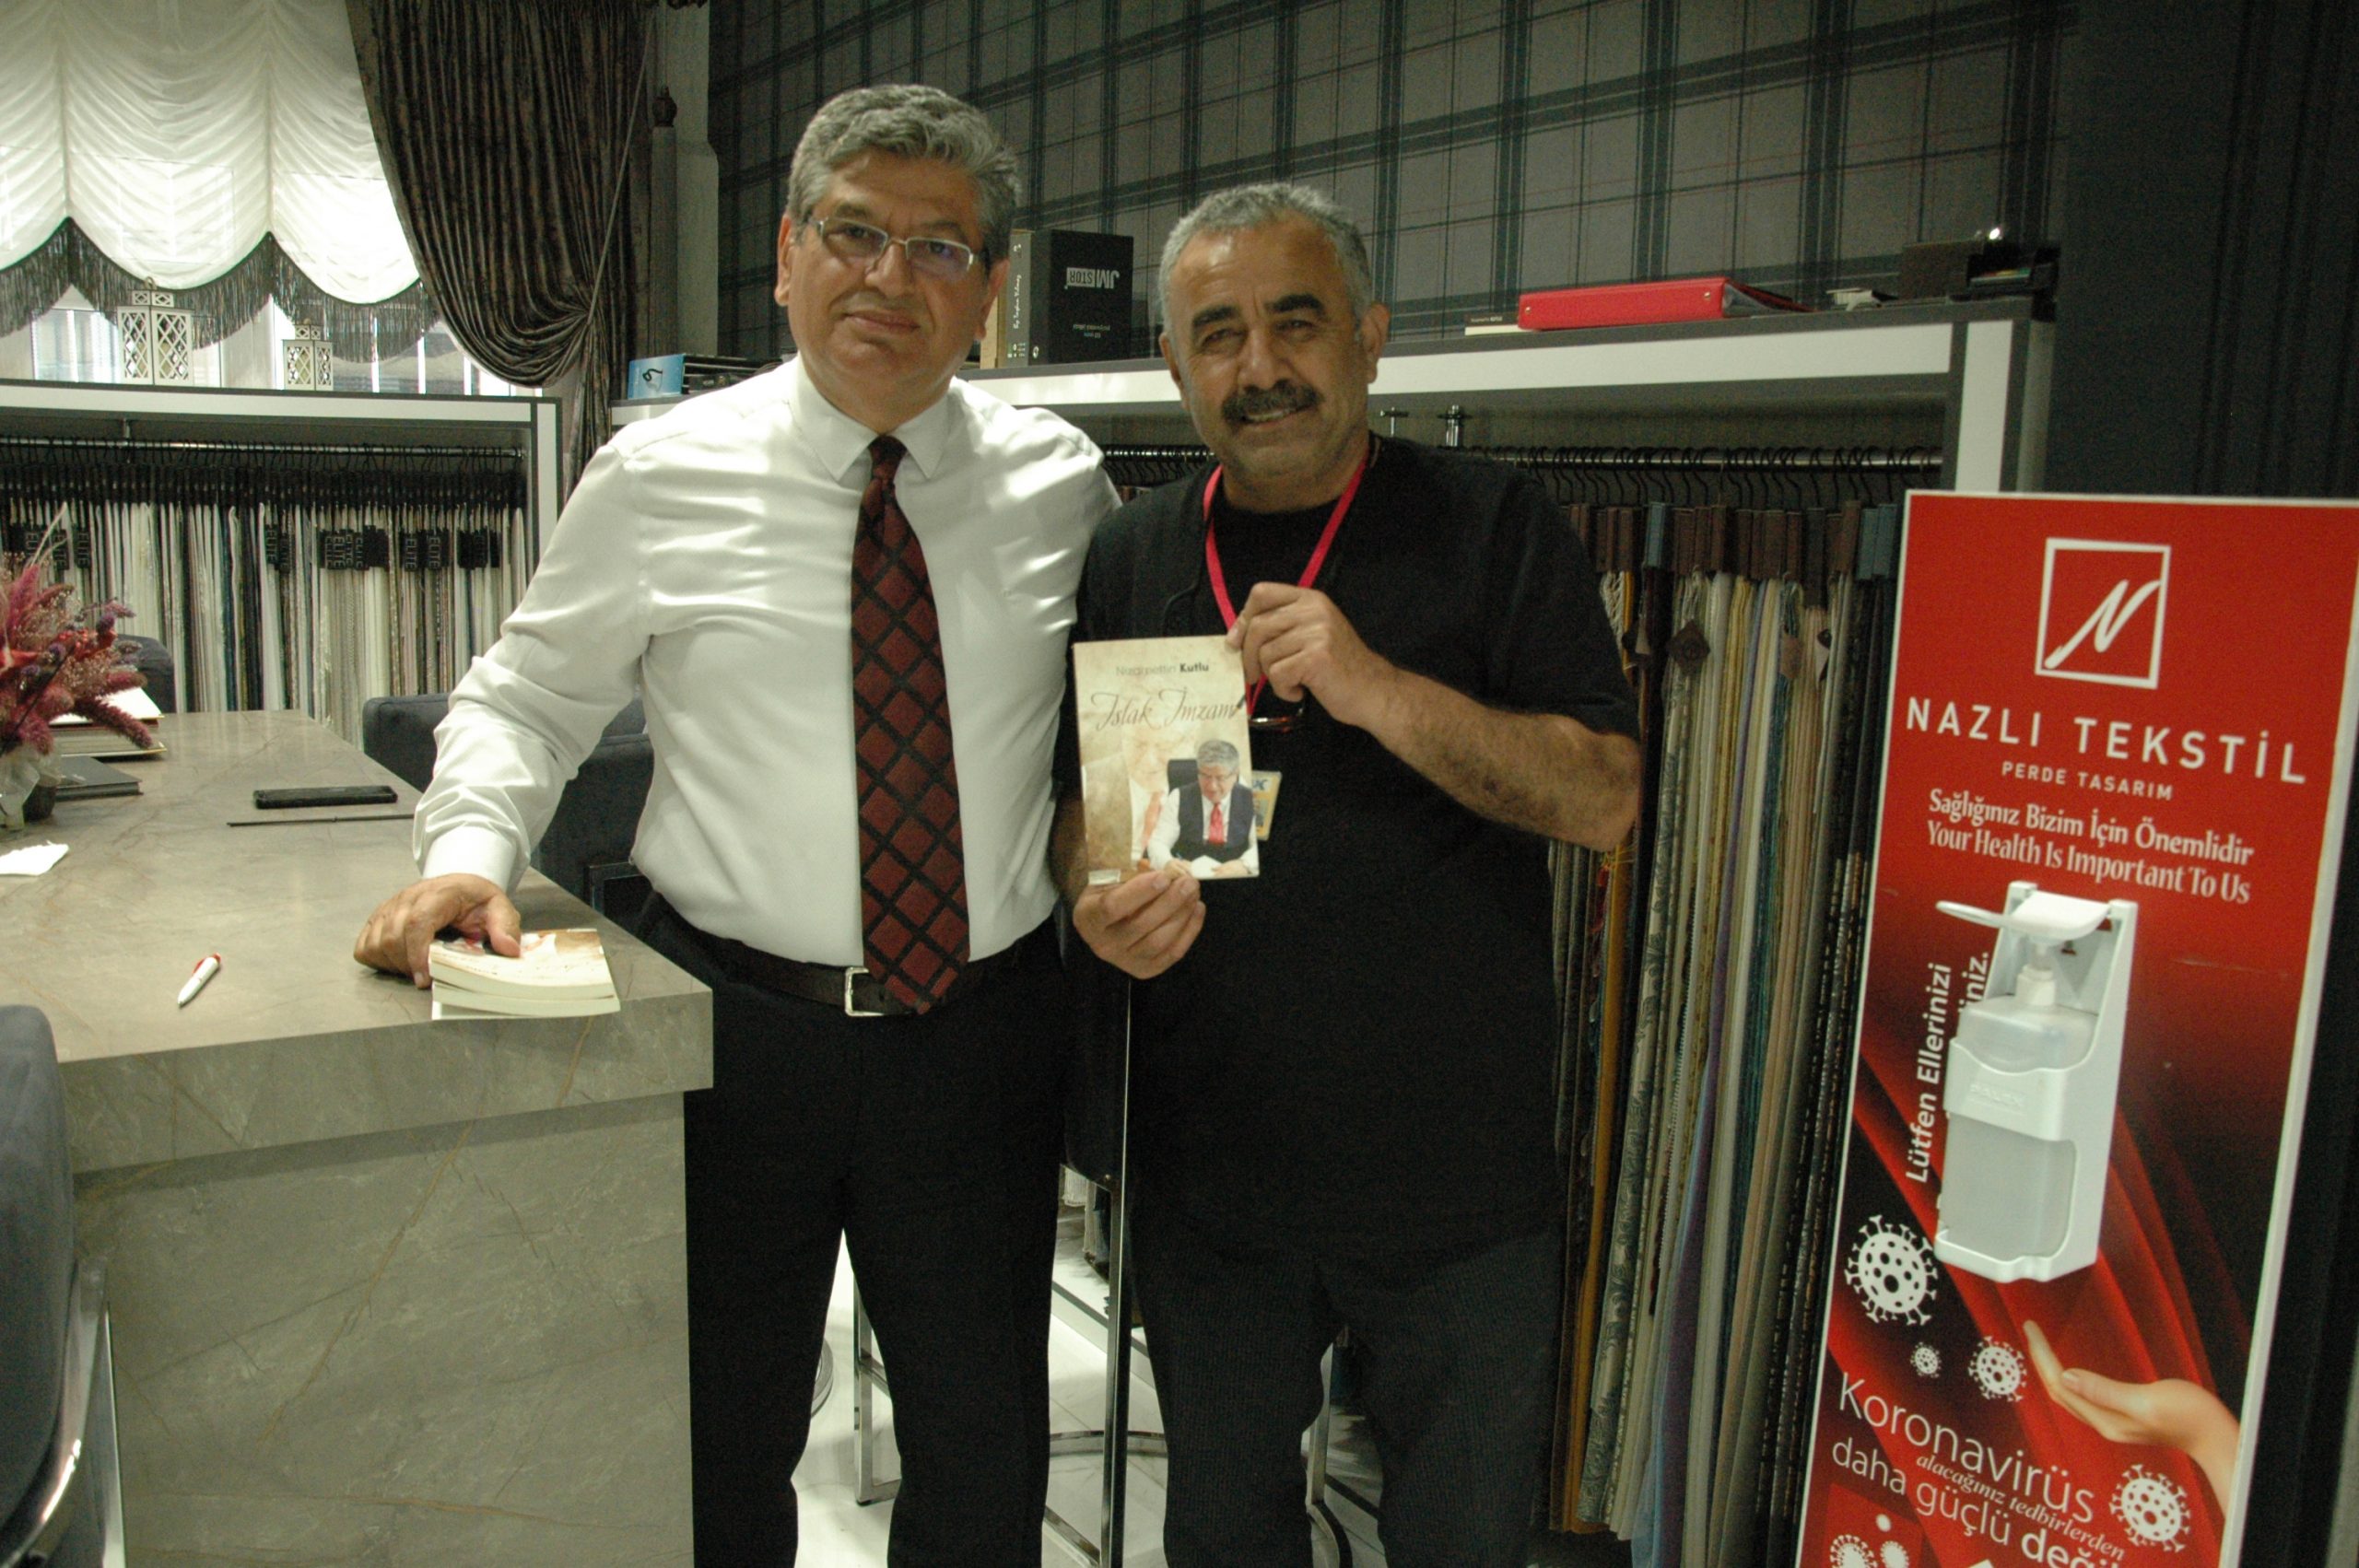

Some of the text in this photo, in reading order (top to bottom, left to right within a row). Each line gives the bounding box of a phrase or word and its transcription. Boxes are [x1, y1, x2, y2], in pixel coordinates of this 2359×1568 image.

[1097, 269, 1121, 289] JM
[405, 537, 417, 569] ELITE
[428, 536, 441, 568] ELITE
[1180, 661, 1209, 673] Kutlu
[1906, 696, 2306, 785] NAZLI TEKSTİL
[2001, 760, 2174, 802] PERDE TASARIM
[1926, 819, 2251, 906] Your Health Is Important To Us
[1928, 787, 2255, 867] Sağlığınız Bizim İçin Önemlidir
[1905, 962, 1952, 1184] Lütfen Ellerinizi
[1838, 1371, 2095, 1524] Koronavirüs
[1832, 1436, 1907, 1495] daha
[1915, 1481, 2011, 1547] güçlü
[1916, 1453, 2125, 1562] alacağınız tedbirlerden
